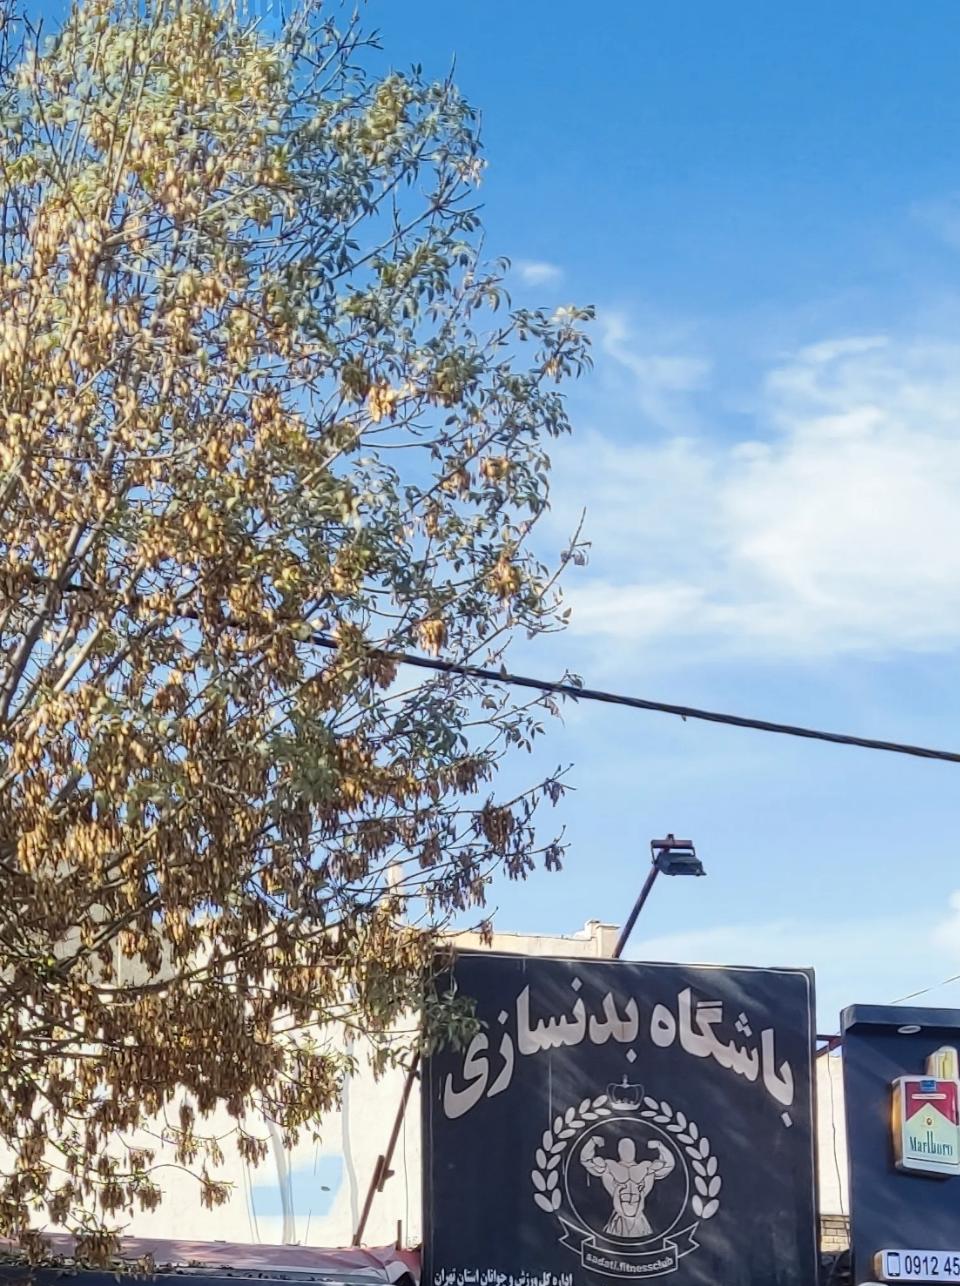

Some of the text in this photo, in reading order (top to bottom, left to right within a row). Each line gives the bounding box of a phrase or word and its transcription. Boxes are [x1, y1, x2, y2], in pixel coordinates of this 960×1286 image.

[444, 977, 795, 1128] باشگاه بدنسازی
[904, 1254, 939, 1276] 0912
[434, 1267, 457, 1286] تهران
[456, 1268, 480, 1286] استان
